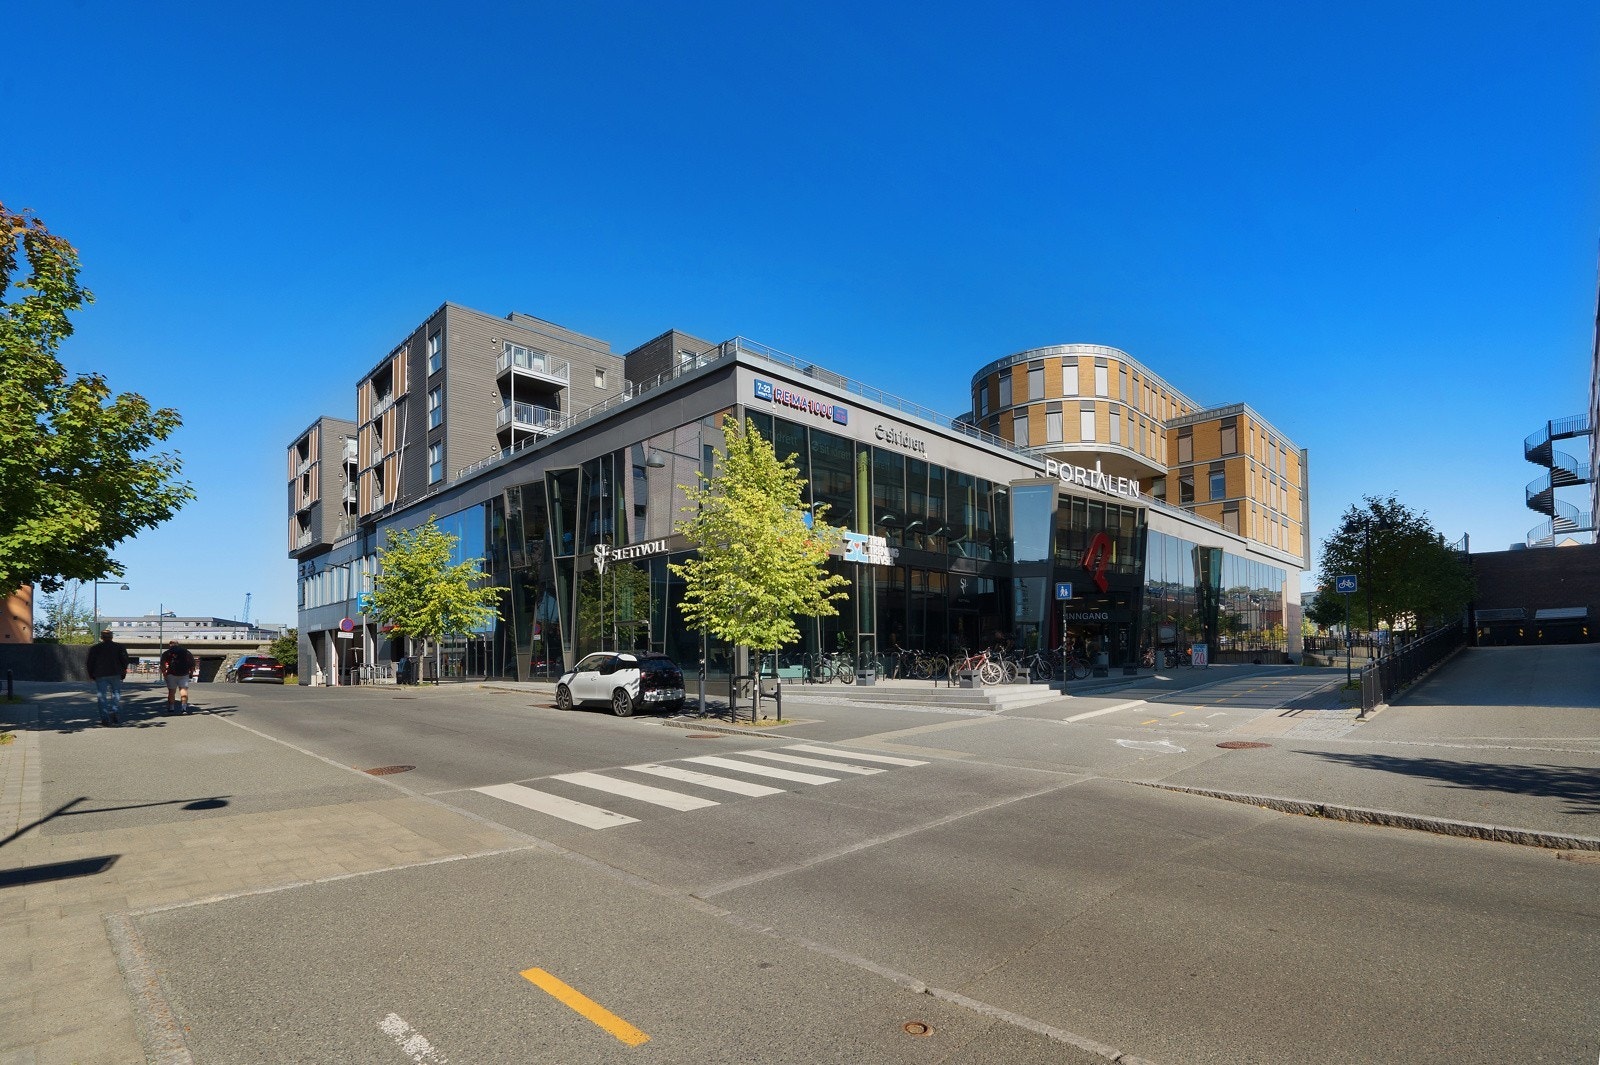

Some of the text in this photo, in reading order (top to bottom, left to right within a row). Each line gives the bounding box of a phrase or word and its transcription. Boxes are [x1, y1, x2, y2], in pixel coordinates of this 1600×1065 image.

[775, 388, 808, 410] REMA
[809, 399, 833, 418] 1000
[1046, 458, 1140, 498] PORTALEN
